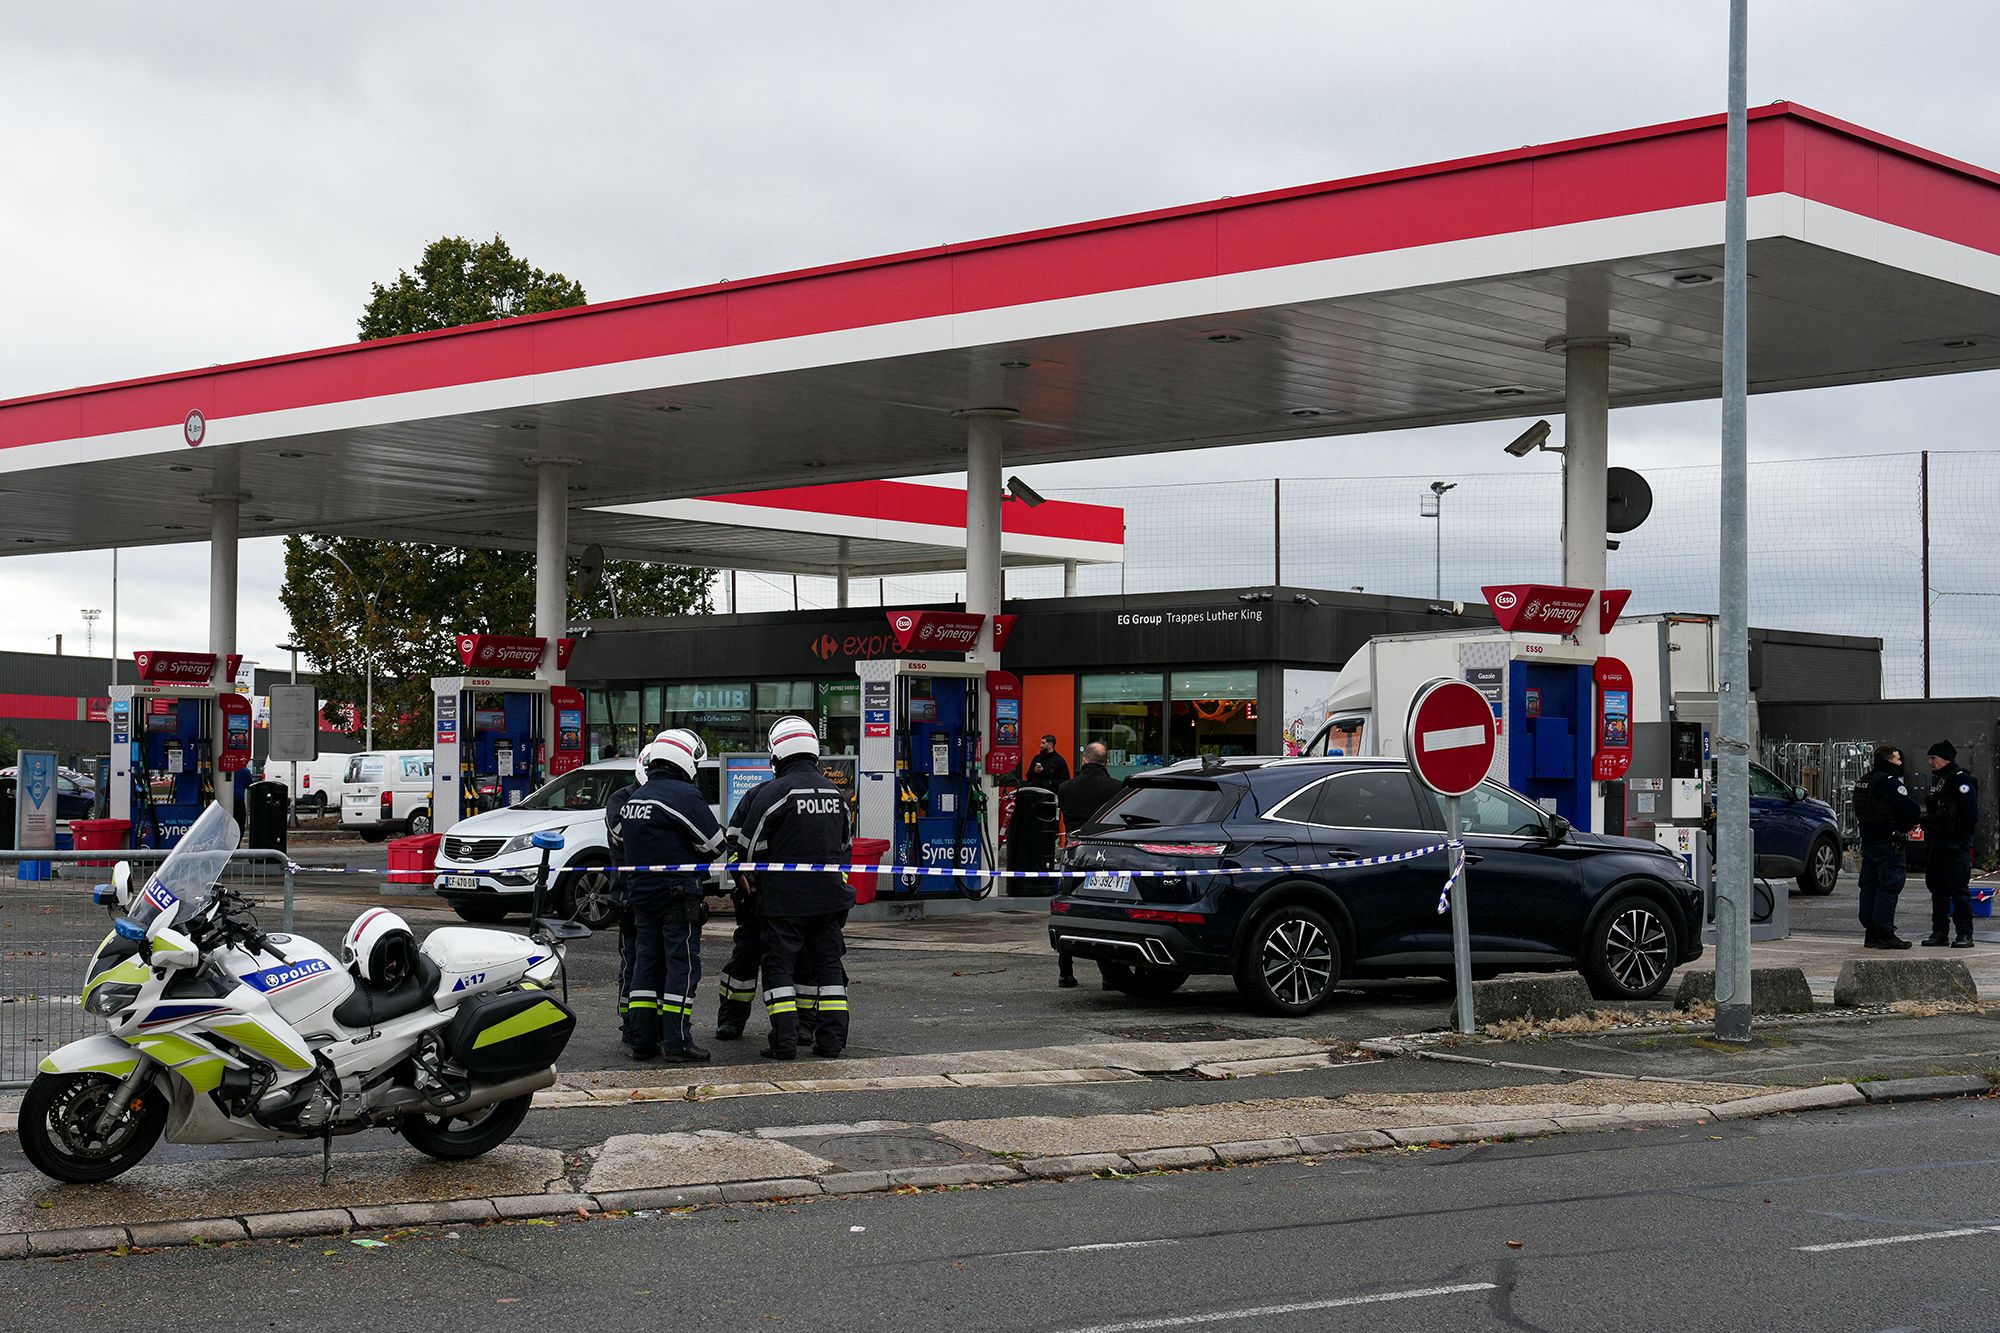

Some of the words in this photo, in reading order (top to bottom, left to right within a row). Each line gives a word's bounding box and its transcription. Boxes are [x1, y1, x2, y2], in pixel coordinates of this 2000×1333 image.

[1498, 595, 1514, 604] Esso
[1540, 603, 1581, 623] Synergy
[1603, 600, 1610, 614] 1
[1117, 614, 1131, 625] EG
[1132, 613, 1162, 627] Group
[1166, 611, 1204, 624] Trappes
[1206, 609, 1239, 622] Luther
[1240, 608, 1263, 623] King
[935, 625, 976, 643] Synergy
[995, 623, 1002, 635] 3
[559, 646, 564, 656] 5
[843, 635, 924, 659] expre
[1526, 645, 1543, 653] ESSO
[497, 648, 539, 662] Synergy
[169, 662, 210, 675] Synergy
[228, 661, 232, 669] 7
[693, 690, 745, 709] CLUB
[957, 738, 962, 747] 3
[732, 774, 762, 782] Adoptez
[796, 799, 841, 815] POLICE
[922, 843, 977, 864] Synegy
[148, 878, 173, 908] LICE
[279, 961, 326, 983] POLICE
[470, 972, 486, 985] 17
